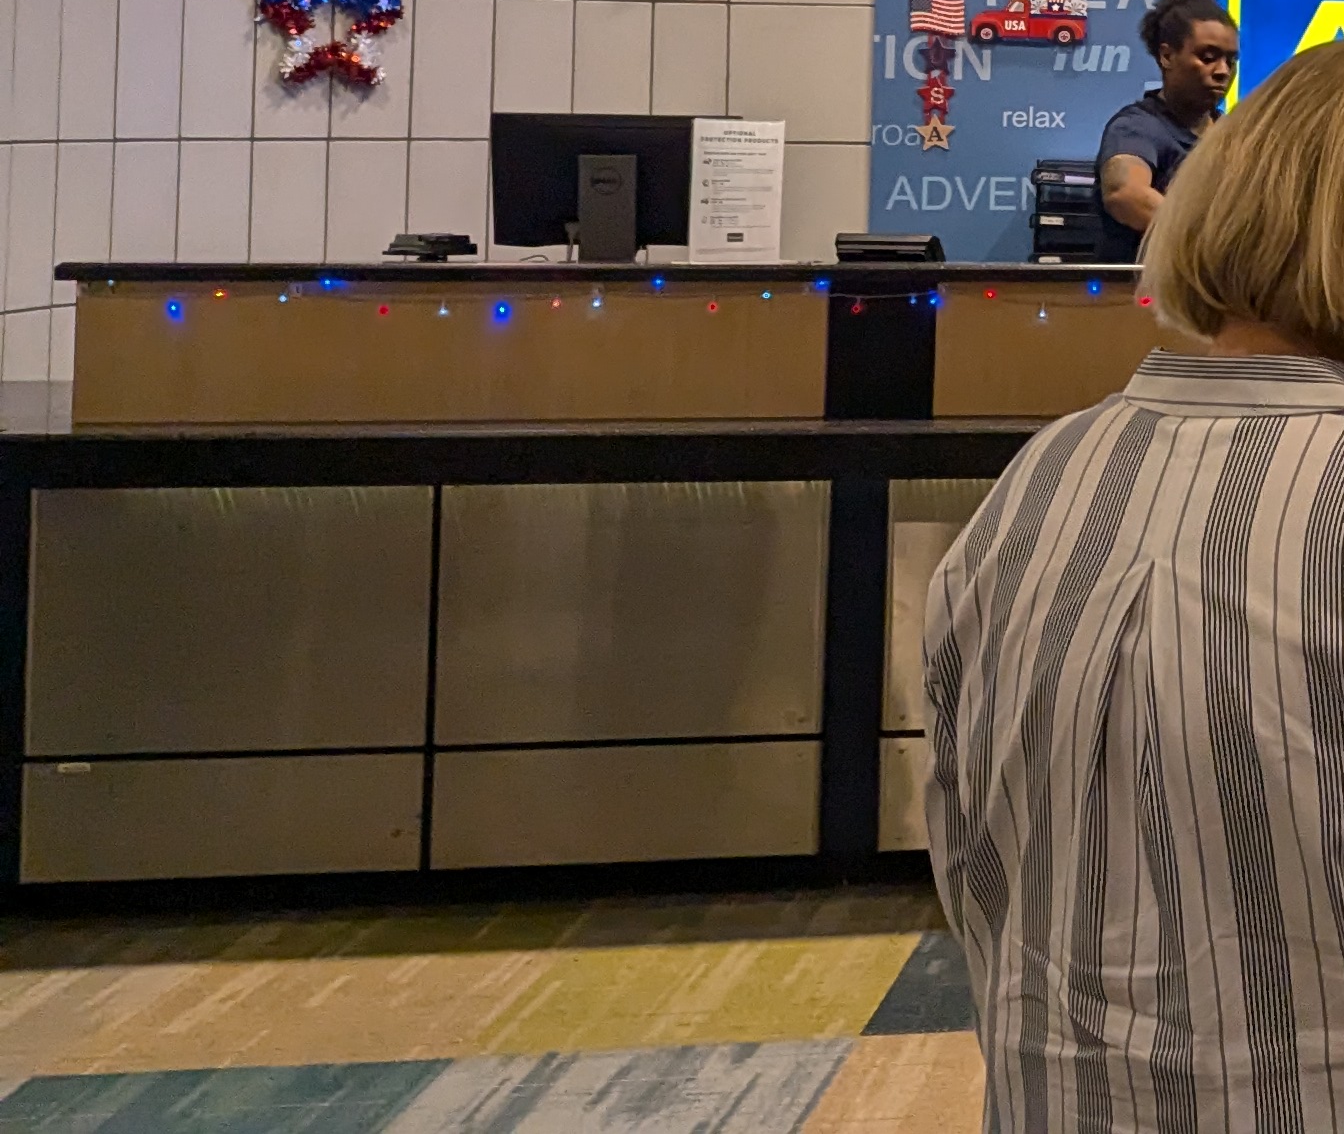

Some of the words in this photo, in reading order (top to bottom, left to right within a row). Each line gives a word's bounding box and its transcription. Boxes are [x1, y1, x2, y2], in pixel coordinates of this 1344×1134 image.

[1004, 19, 1026, 31] USA
[874, 32, 992, 81] ION
[1002, 106, 1066, 128] relax
